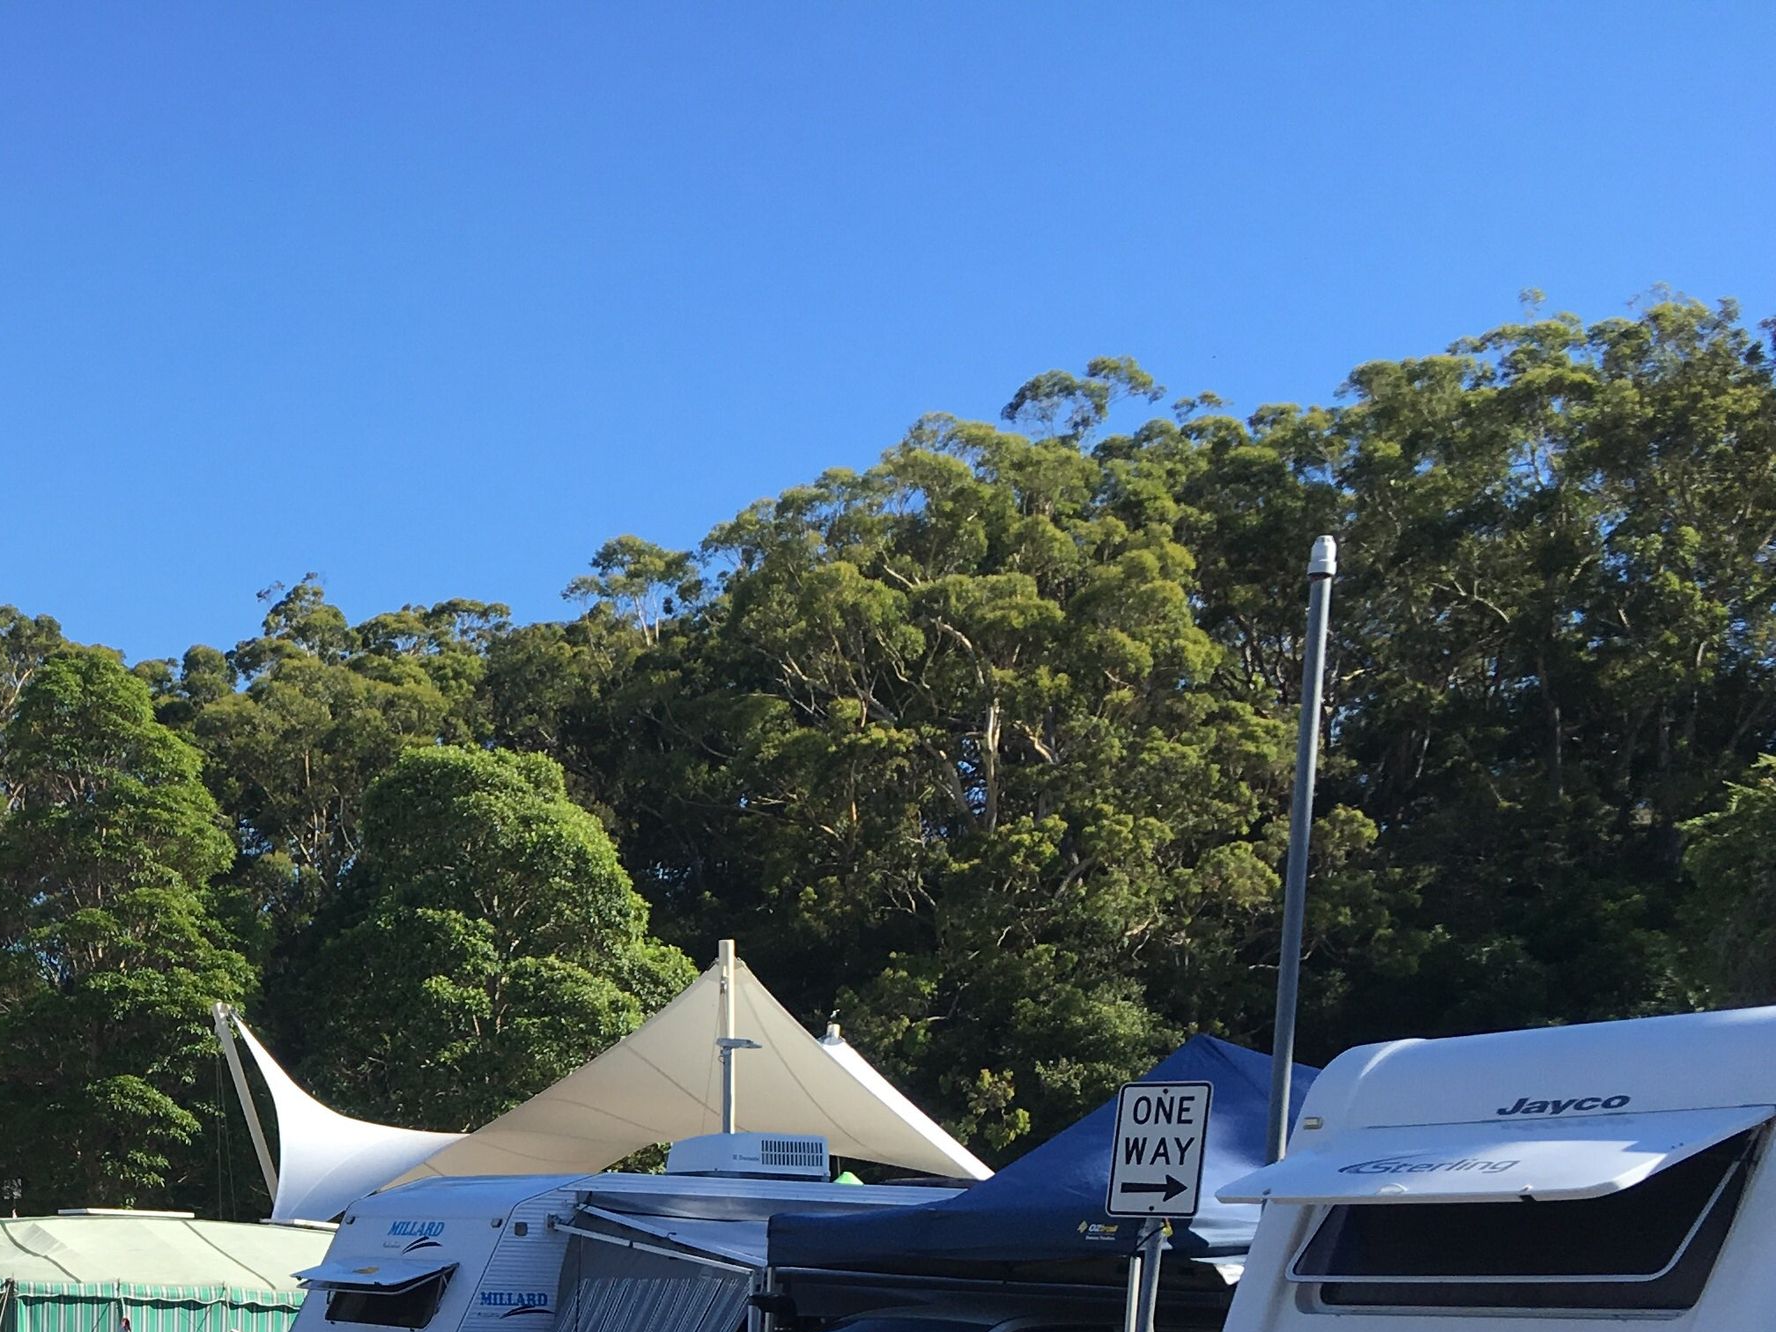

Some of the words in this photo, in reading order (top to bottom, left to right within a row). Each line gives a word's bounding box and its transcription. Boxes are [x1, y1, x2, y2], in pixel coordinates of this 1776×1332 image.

[1132, 1095, 1195, 1125] ONE
[1496, 1094, 1631, 1116] Jayco
[1125, 1136, 1195, 1165] WAY
[1365, 1157, 1521, 1174] Sterling
[387, 1221, 445, 1237] MILLARD
[480, 1291, 548, 1306] MILLARD
